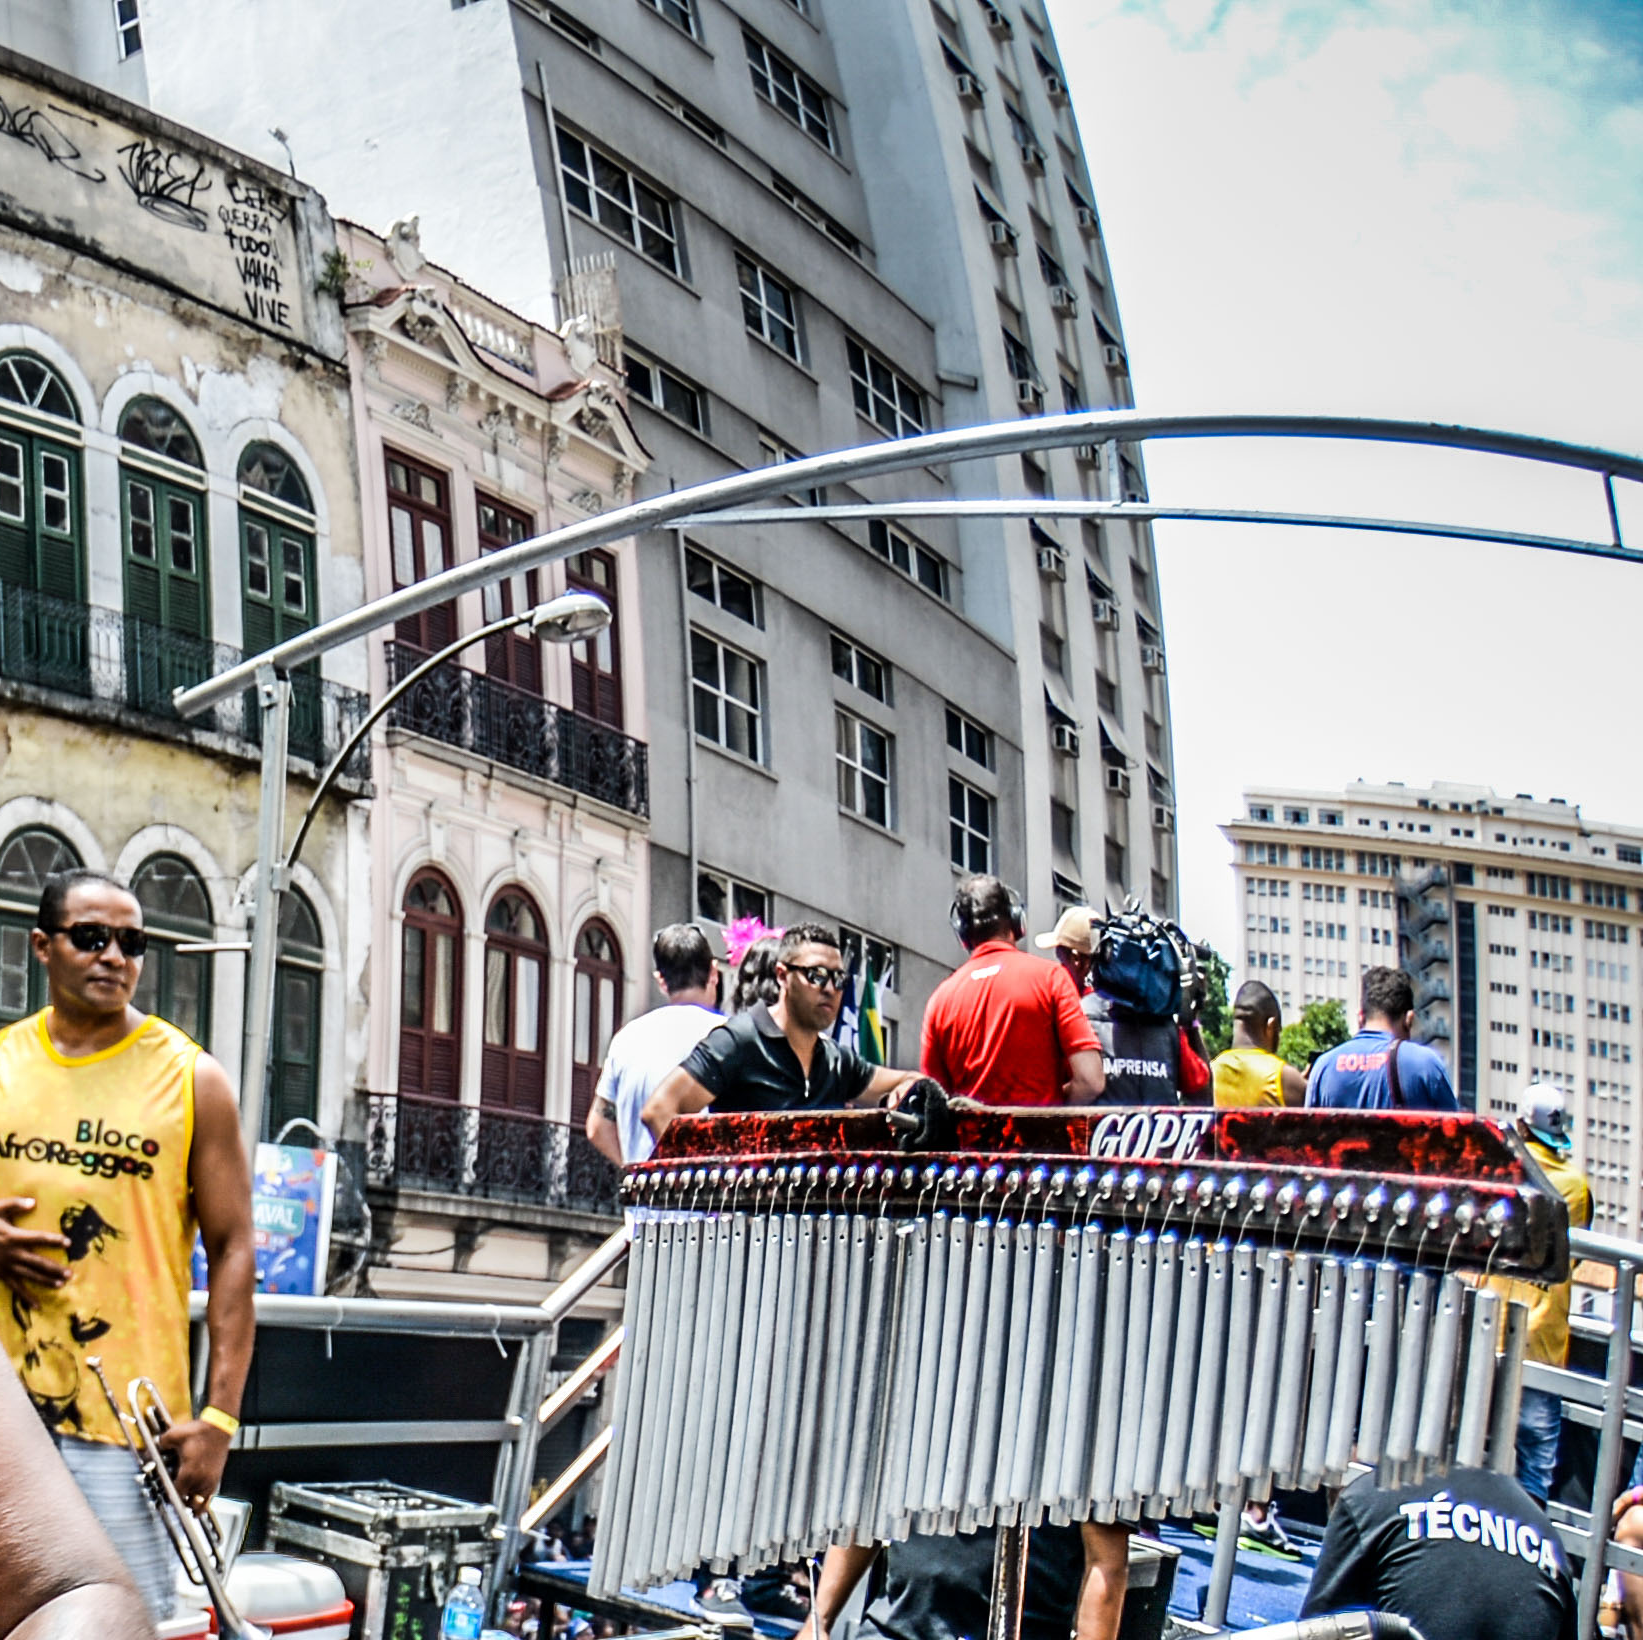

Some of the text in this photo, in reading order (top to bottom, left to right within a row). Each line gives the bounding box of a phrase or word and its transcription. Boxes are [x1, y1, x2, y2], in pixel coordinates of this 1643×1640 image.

[245, 291, 292, 329] VIVE
[1103, 1058, 1168, 1078] IMPRENSA
[1336, 1052, 1389, 1072] EQUIP
[76, 1118, 160, 1157] Bloco
[1090, 1113, 1212, 1162] GOPE
[1400, 1490, 1558, 1580] TÉCNICA
